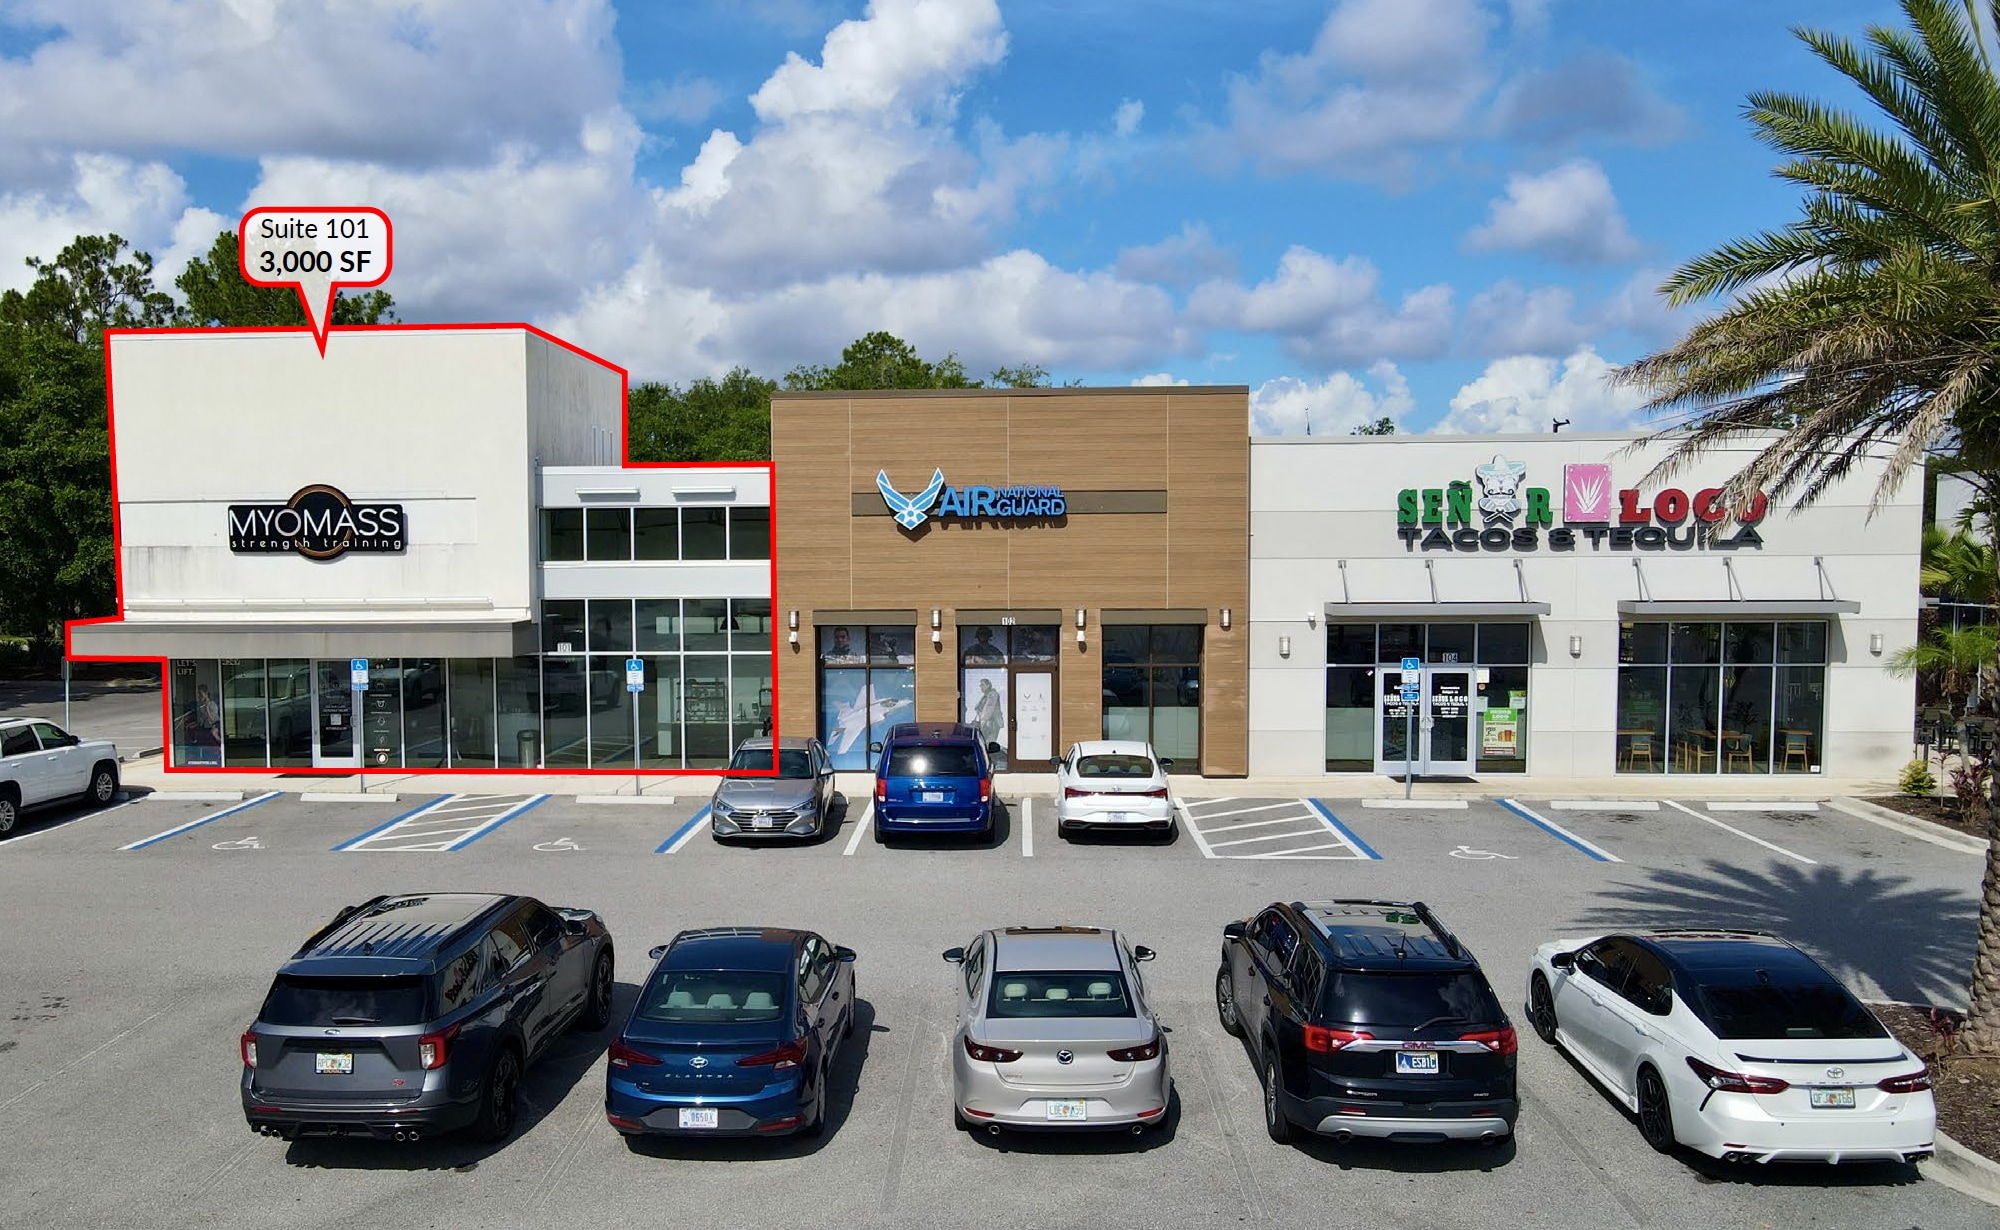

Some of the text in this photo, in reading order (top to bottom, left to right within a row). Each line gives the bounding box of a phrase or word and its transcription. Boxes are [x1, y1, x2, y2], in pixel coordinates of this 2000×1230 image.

[997, 485, 1065, 498] NATIONAL
[938, 484, 996, 517] AIR
[1619, 488, 1767, 523] LOCO
[996, 499, 1066, 516] GUARD
[228, 508, 401, 537] MYOMASS
[231, 537, 401, 550] strength training
[1397, 527, 1539, 548] TACOS
[1549, 527, 1577, 548] &
[1001, 616, 1016, 625] 102
[558, 643, 572, 652] 101
[1442, 652, 1458, 662] 104
[1401, 1042, 1435, 1050] GMC
